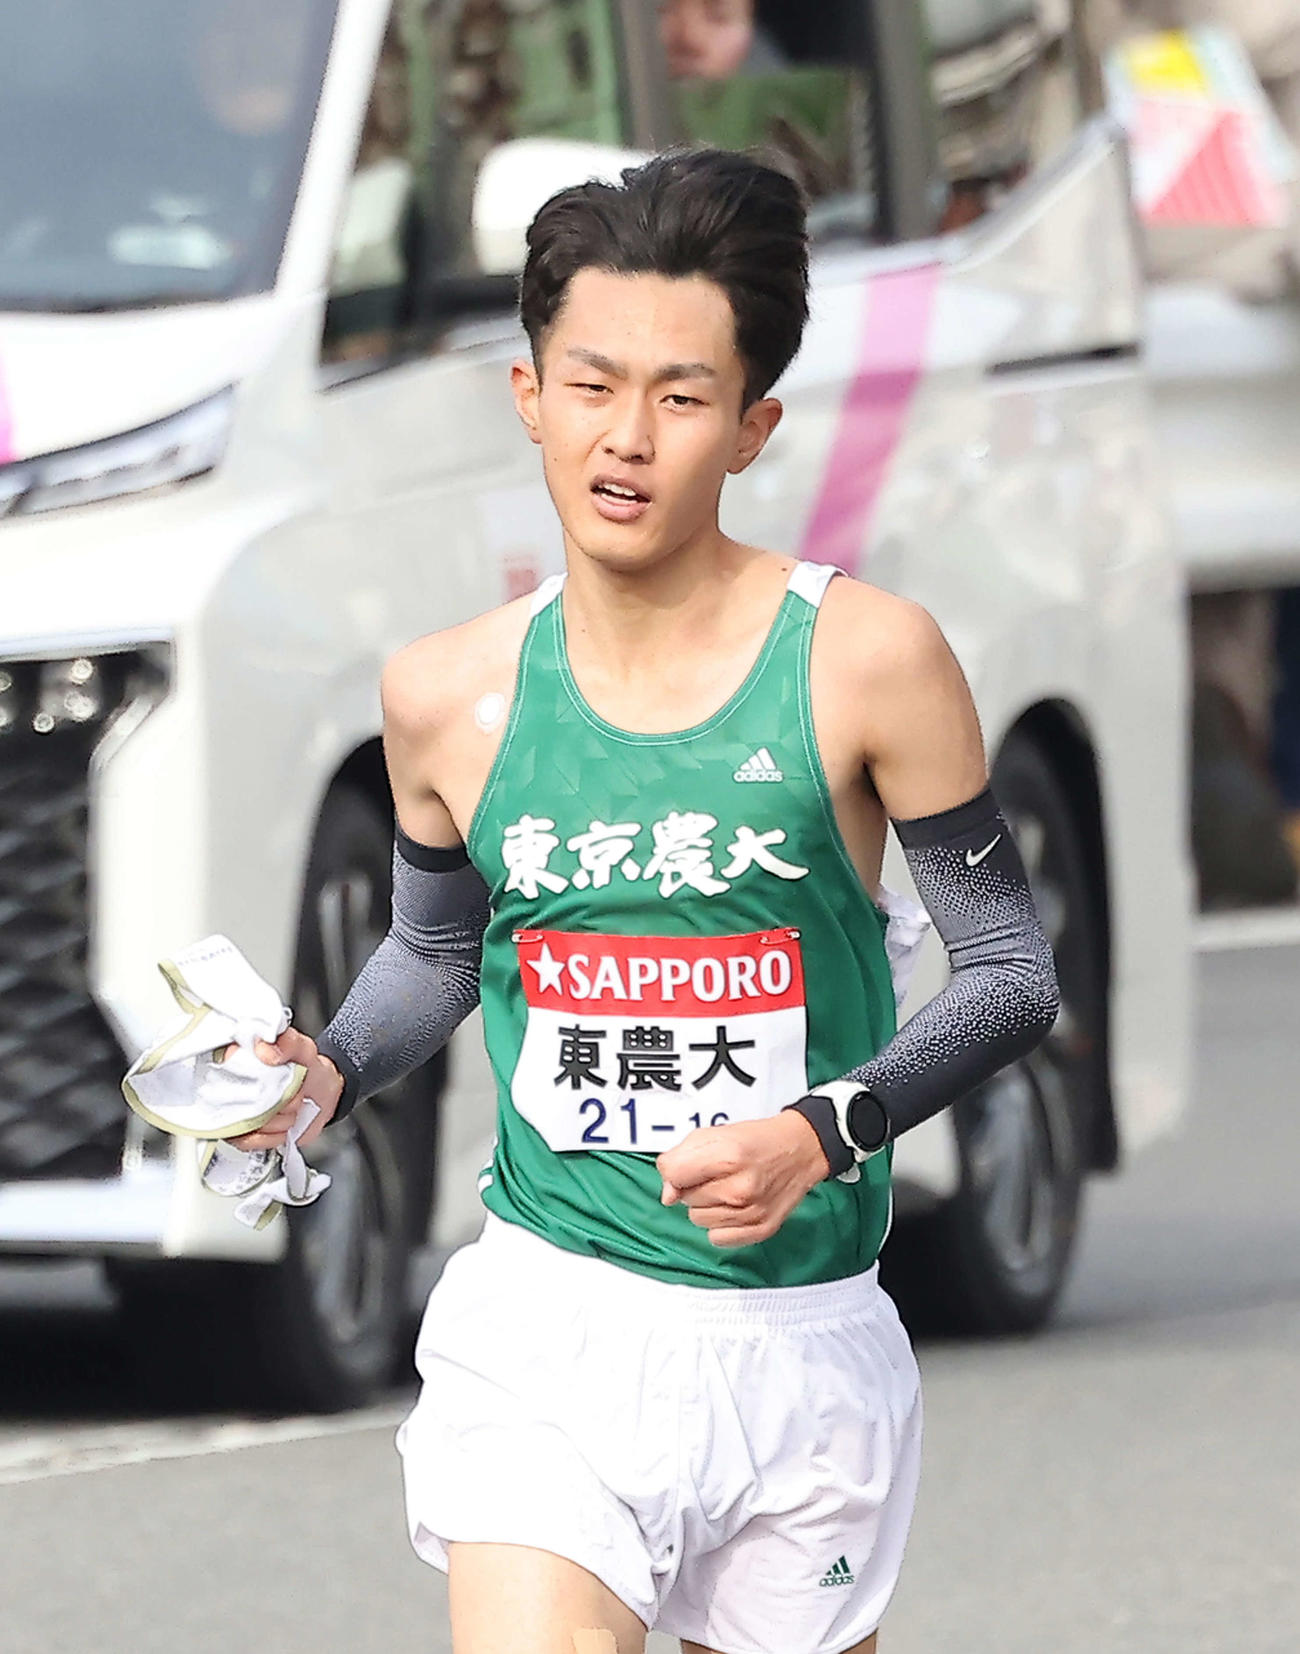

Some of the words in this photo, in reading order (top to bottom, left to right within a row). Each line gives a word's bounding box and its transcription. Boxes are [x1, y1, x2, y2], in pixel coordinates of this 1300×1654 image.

[733, 769, 783, 782] adidas
[501, 811, 810, 899] 東京農大
[567, 949, 793, 1003] SAPPORO
[553, 1024, 757, 1093] 東農大
